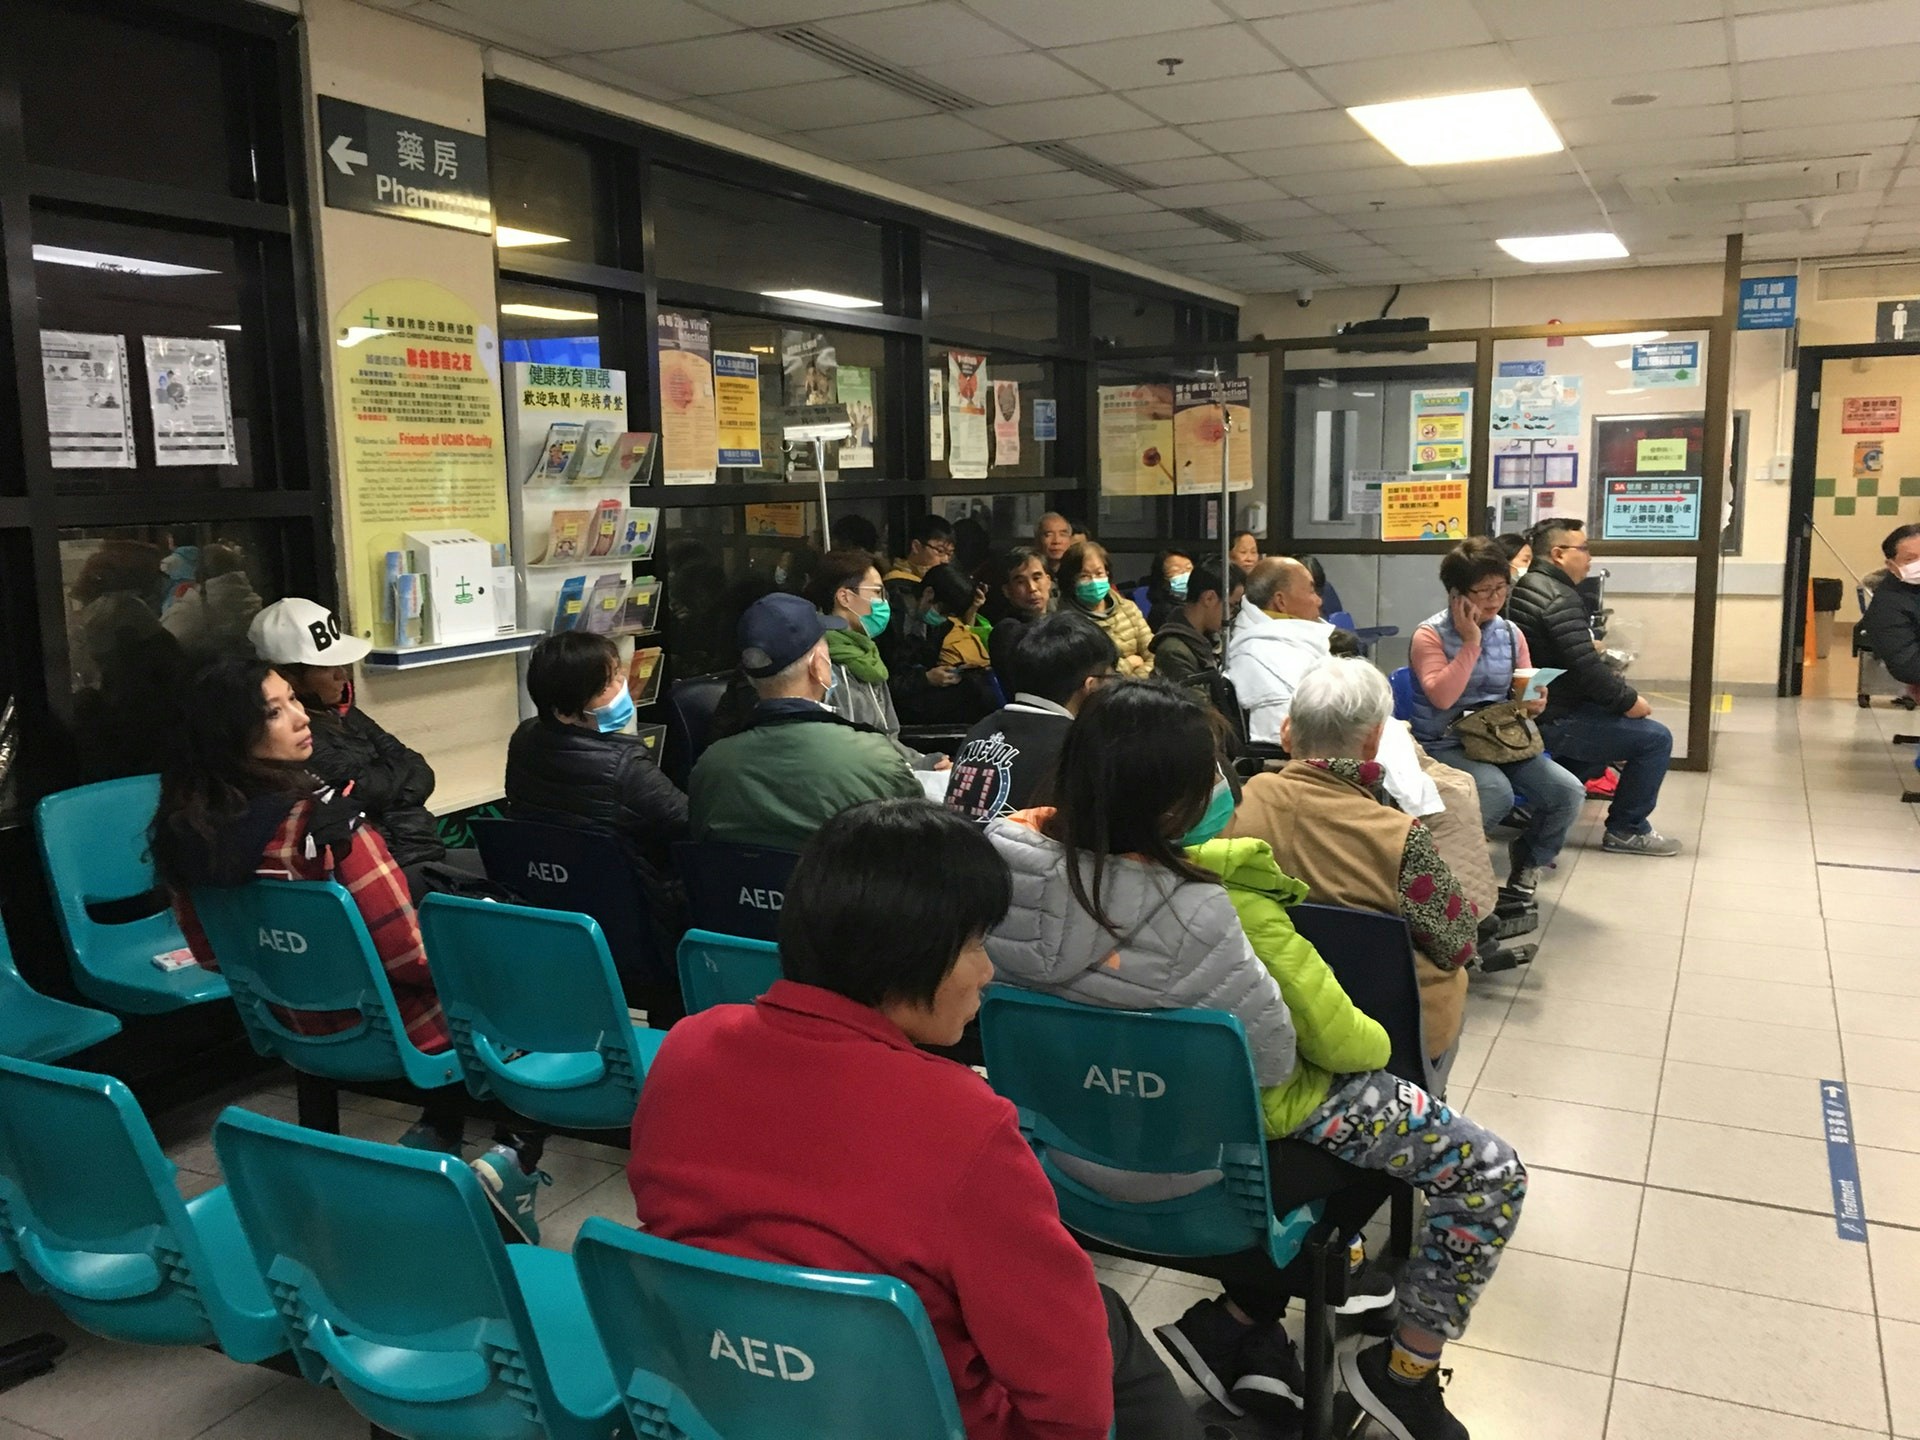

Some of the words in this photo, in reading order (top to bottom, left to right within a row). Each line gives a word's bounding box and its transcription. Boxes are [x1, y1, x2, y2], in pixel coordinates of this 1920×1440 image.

[396, 130, 459, 180] 藥房
[528, 364, 611, 389] 健康教育單張
[1226, 380, 1247, 388] Virus
[399, 432, 430, 446] Friends
[431, 433, 440, 446] of
[466, 434, 493, 450] Charity
[527, 861, 569, 883] AED
[738, 886, 785, 911] AED
[258, 926, 308, 954] AED
[1838, 1179, 1859, 1220] Treatment
[709, 1328, 816, 1381] AED
